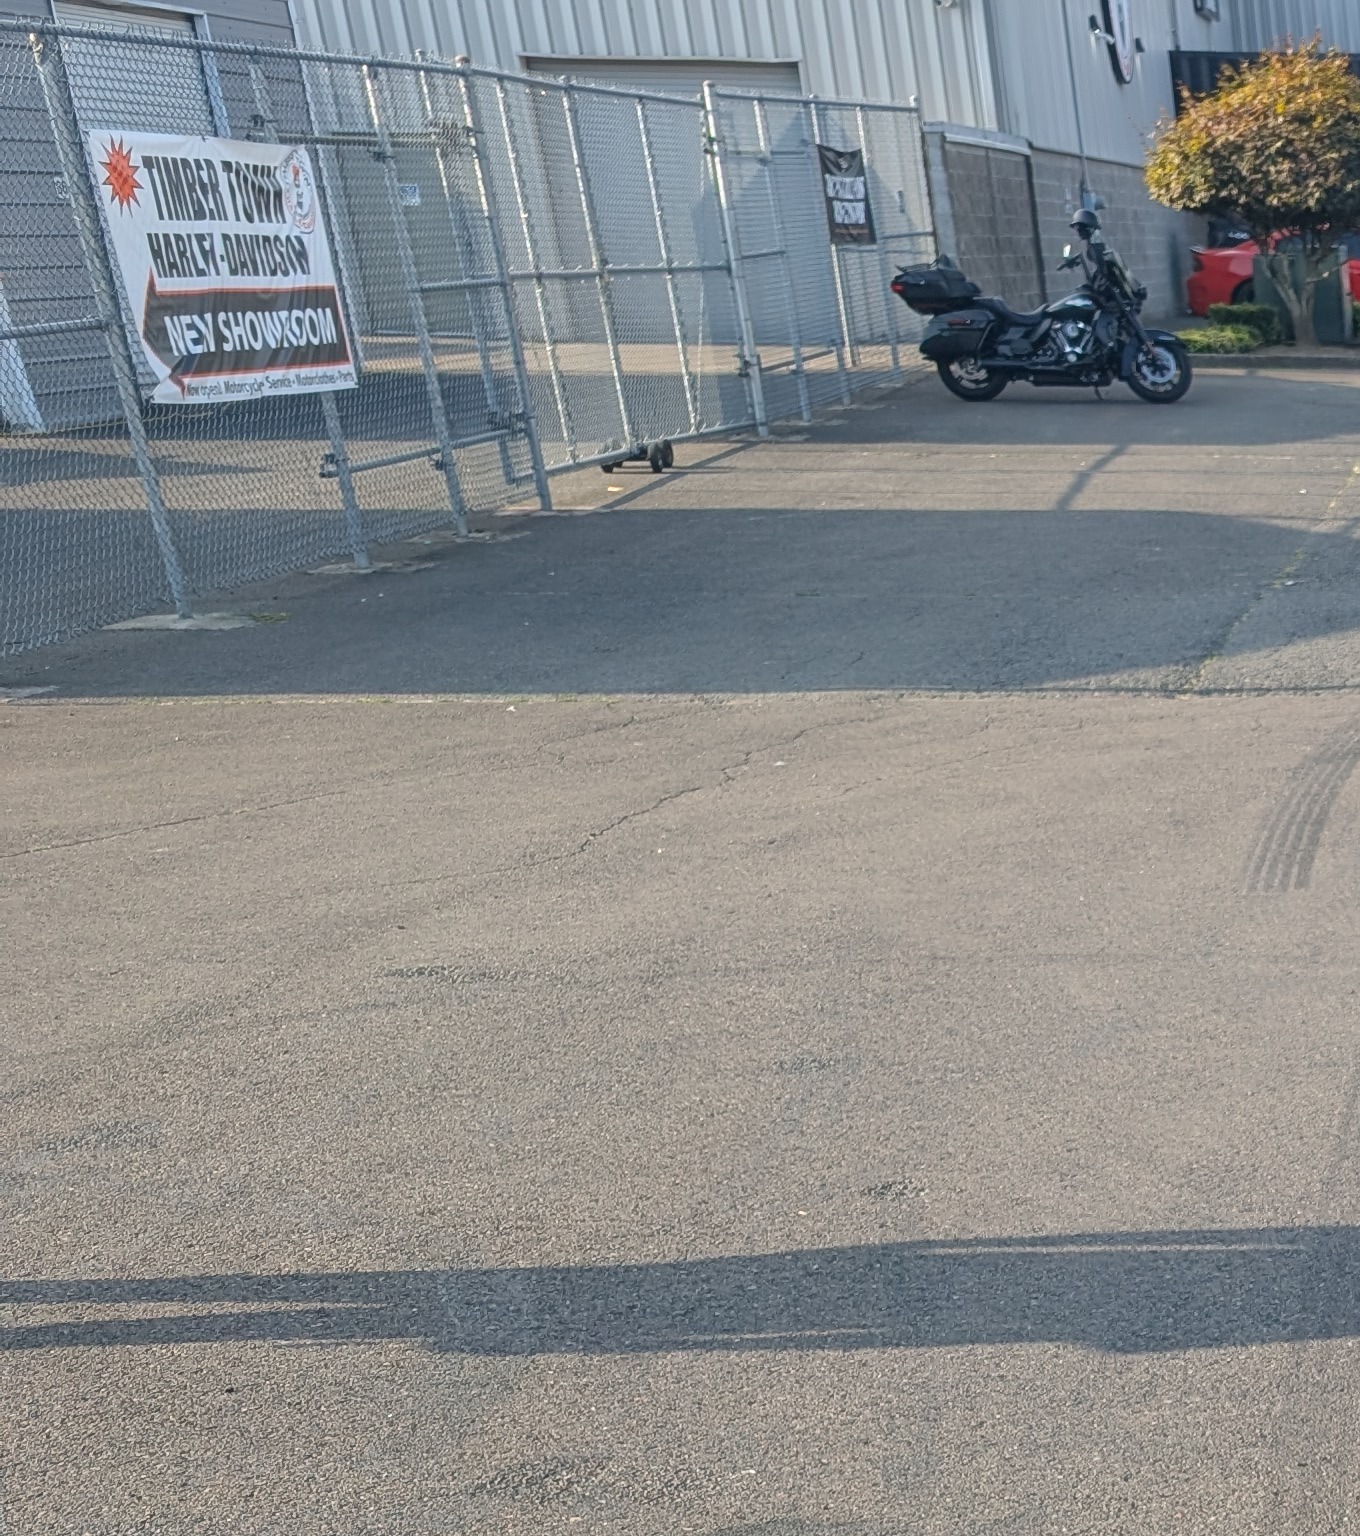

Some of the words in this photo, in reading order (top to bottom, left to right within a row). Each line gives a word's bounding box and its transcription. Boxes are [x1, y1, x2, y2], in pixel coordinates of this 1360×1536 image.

[141, 155, 228, 222] TIMBER
[222, 160, 287, 224] TOWN
[147, 232, 311, 279] HARLEY-DAVIDSON
[217, 307, 338, 351] SHOWROOM
[265, 375, 292, 390] Service
